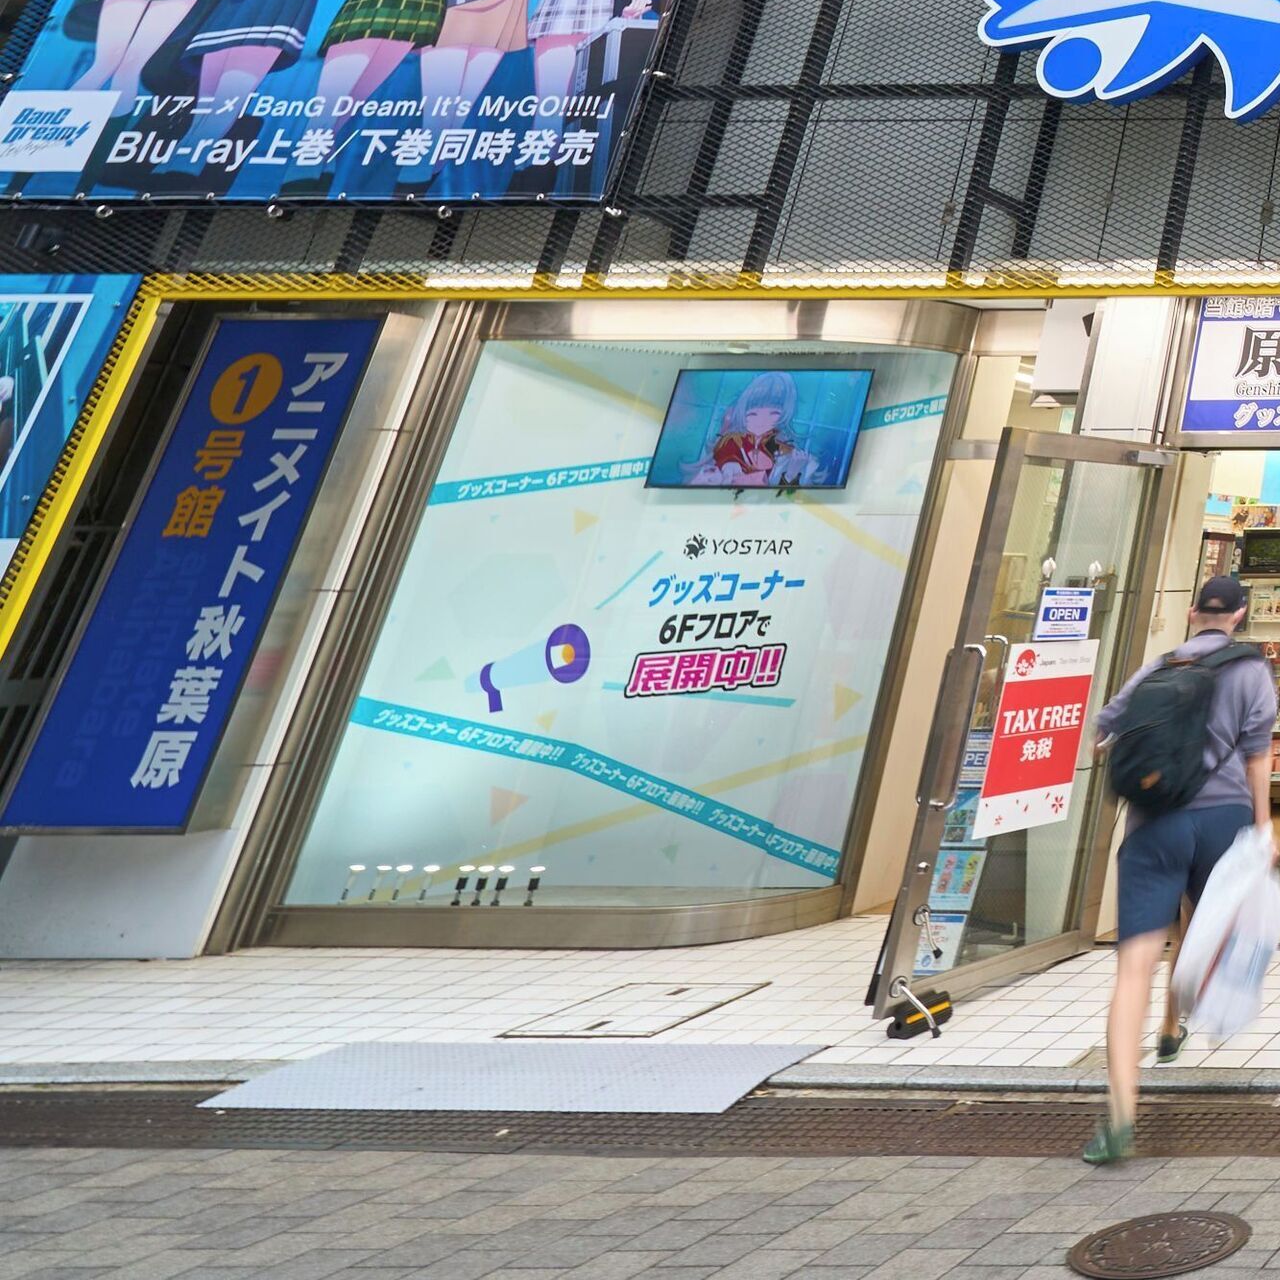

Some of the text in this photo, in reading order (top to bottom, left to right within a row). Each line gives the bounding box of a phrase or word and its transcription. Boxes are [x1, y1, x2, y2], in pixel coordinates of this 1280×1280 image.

[331, 94, 425, 118] Dream!
[431, 94, 472, 117] It's
[457, 474, 544, 500] グッズコーナー
[711, 538, 793, 556] YOSTAR
[130, 351, 349, 791] アニメイト秋葉原
[648, 569, 806, 608] グッズコーナー
[658, 609, 772, 645] 6Fフロアで
[1048, 608, 1081, 621] OPEN
[627, 645, 786, 696] 展開中!!
[372, 708, 458, 736] グッズコーナー
[1003, 702, 1083, 735] TAX FREE
[1019, 736, 1054, 763] 免税
[571, 752, 628, 783] グッズコーナー
